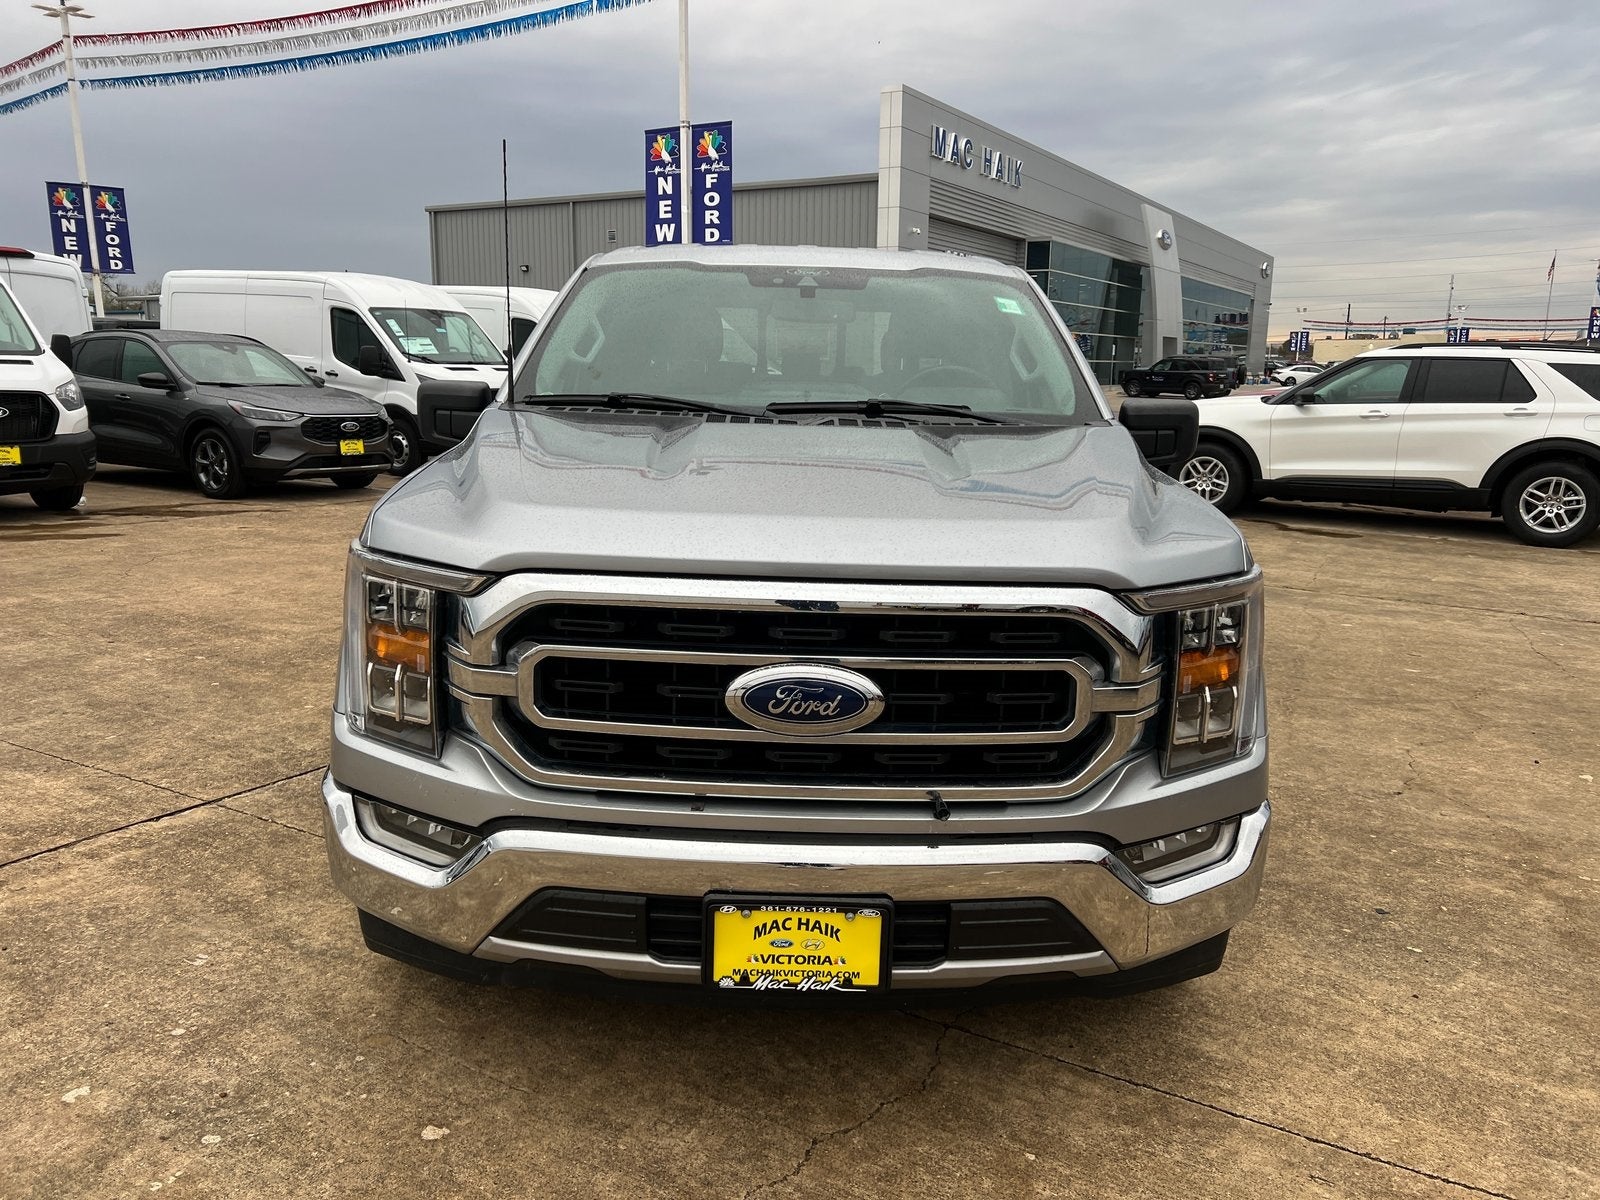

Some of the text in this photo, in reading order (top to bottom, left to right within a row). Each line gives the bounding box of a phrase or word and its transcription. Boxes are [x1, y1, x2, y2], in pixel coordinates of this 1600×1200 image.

[931, 124, 1024, 188] MAC HAIK
[655, 176, 675, 242] NEW
[703, 173, 721, 243] FORD
[105, 221, 123, 270] FORD
[1590, 319, 1600, 339] NEW
[767, 684, 842, 716] Ford
[760, 905, 837, 914] 361-576-1221
[753, 917, 842, 943] MAC HAIK
[760, 954, 833, 966] VICTORIA
[752, 975, 843, 992] Mac Haik
